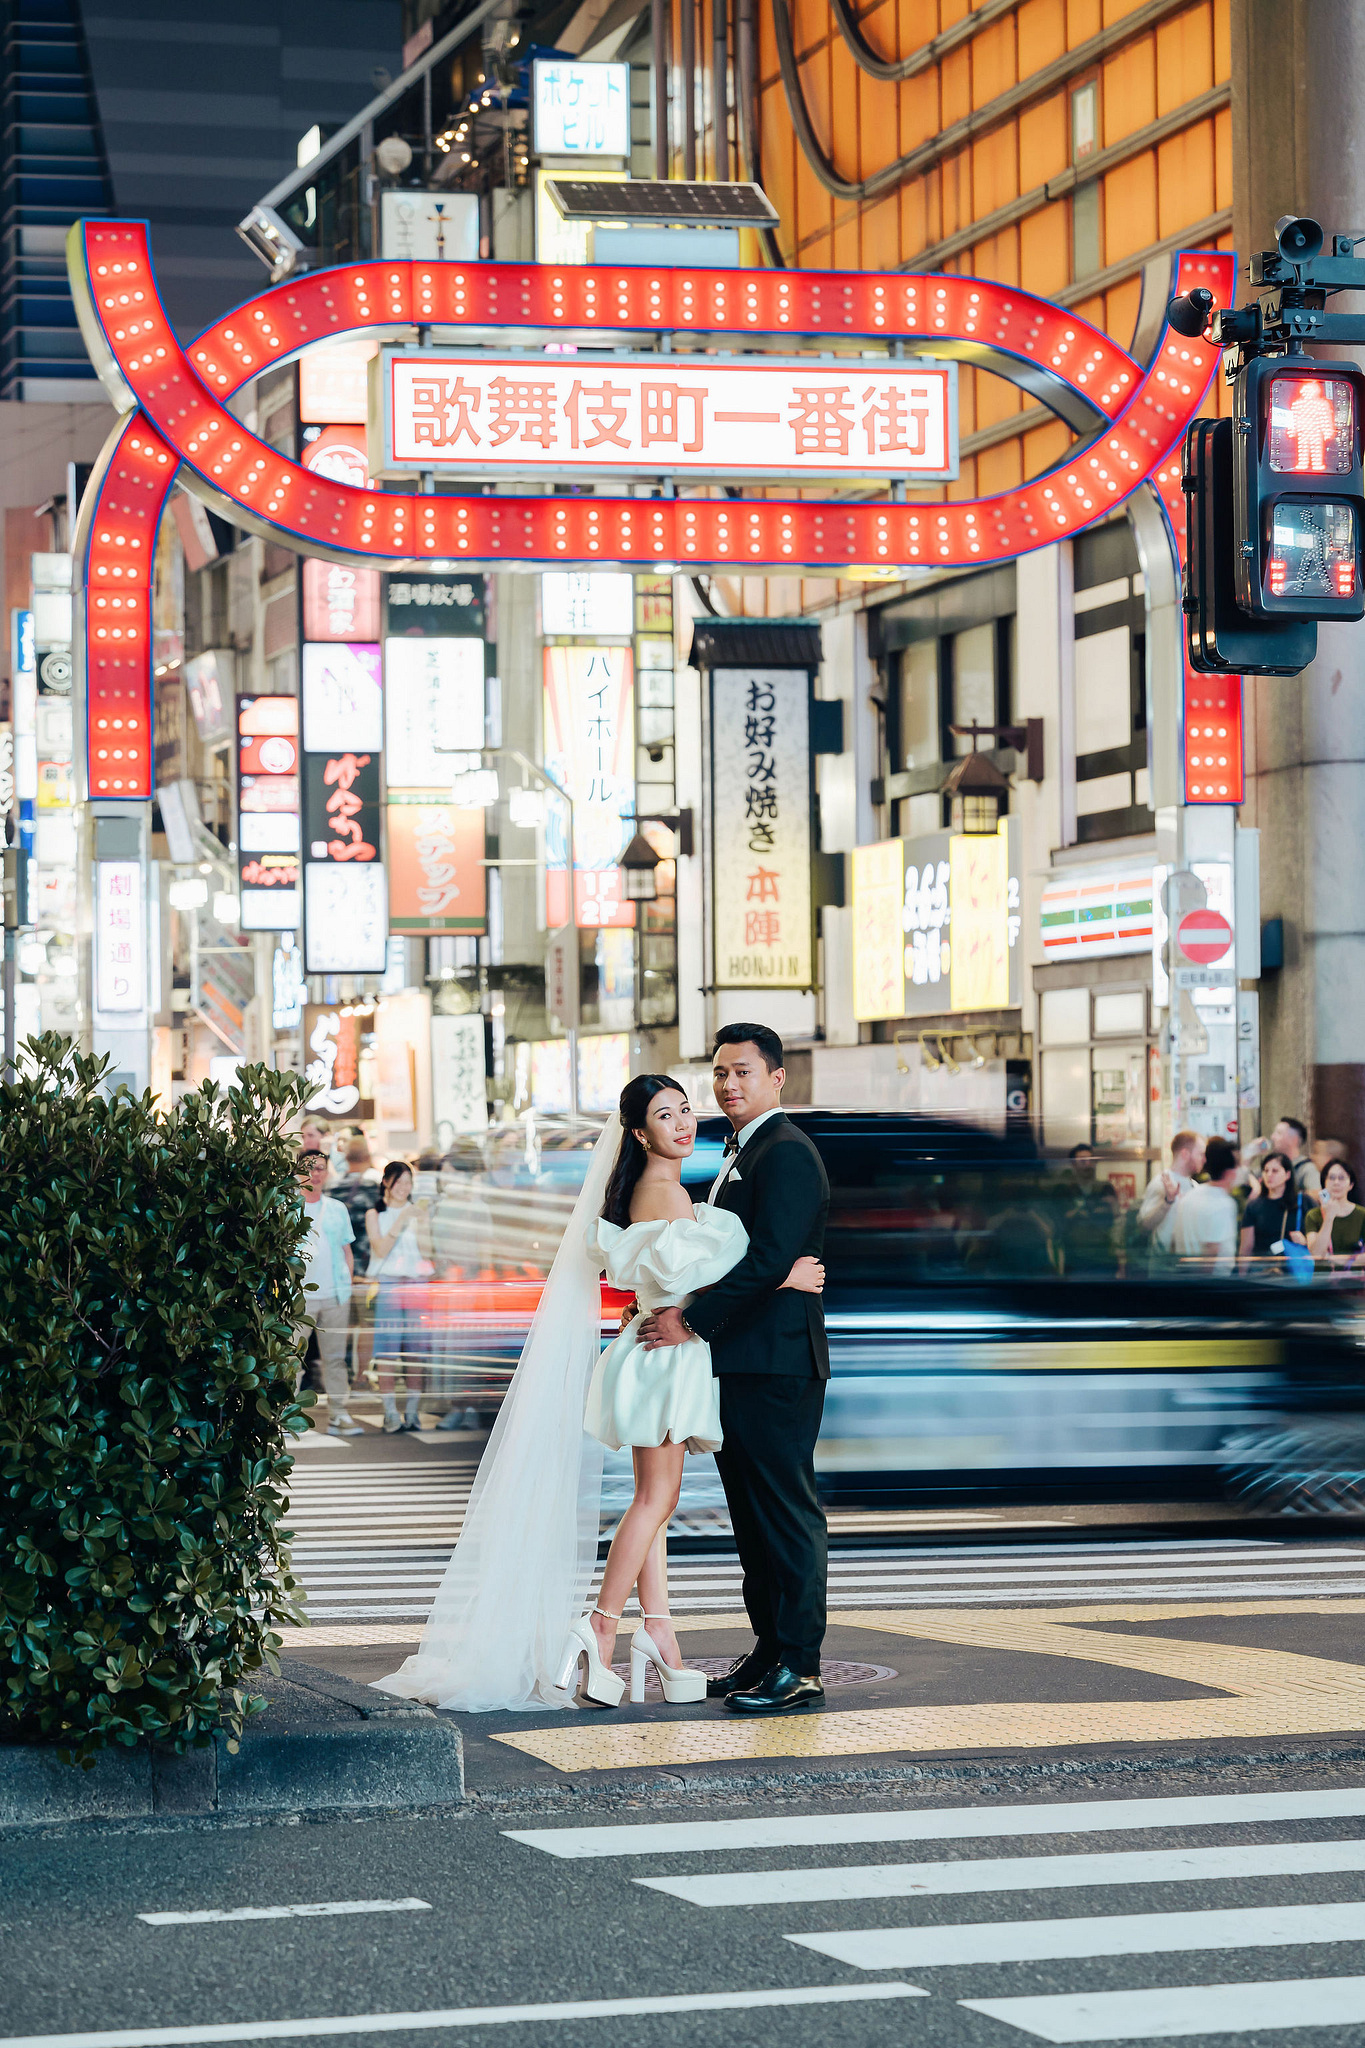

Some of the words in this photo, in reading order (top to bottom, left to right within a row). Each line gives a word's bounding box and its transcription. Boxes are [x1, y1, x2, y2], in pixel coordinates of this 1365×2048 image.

[411, 375, 930, 456] 歌舞伎町一番街
[745, 680, 778, 854] お好み焼き
[581, 900, 619, 926] 2F
[583, 871, 619, 898] 1F
[744, 865, 781, 948] 本陣
[109, 873, 132, 997] 劇場通り
[728, 954, 801, 979] HONJIN
